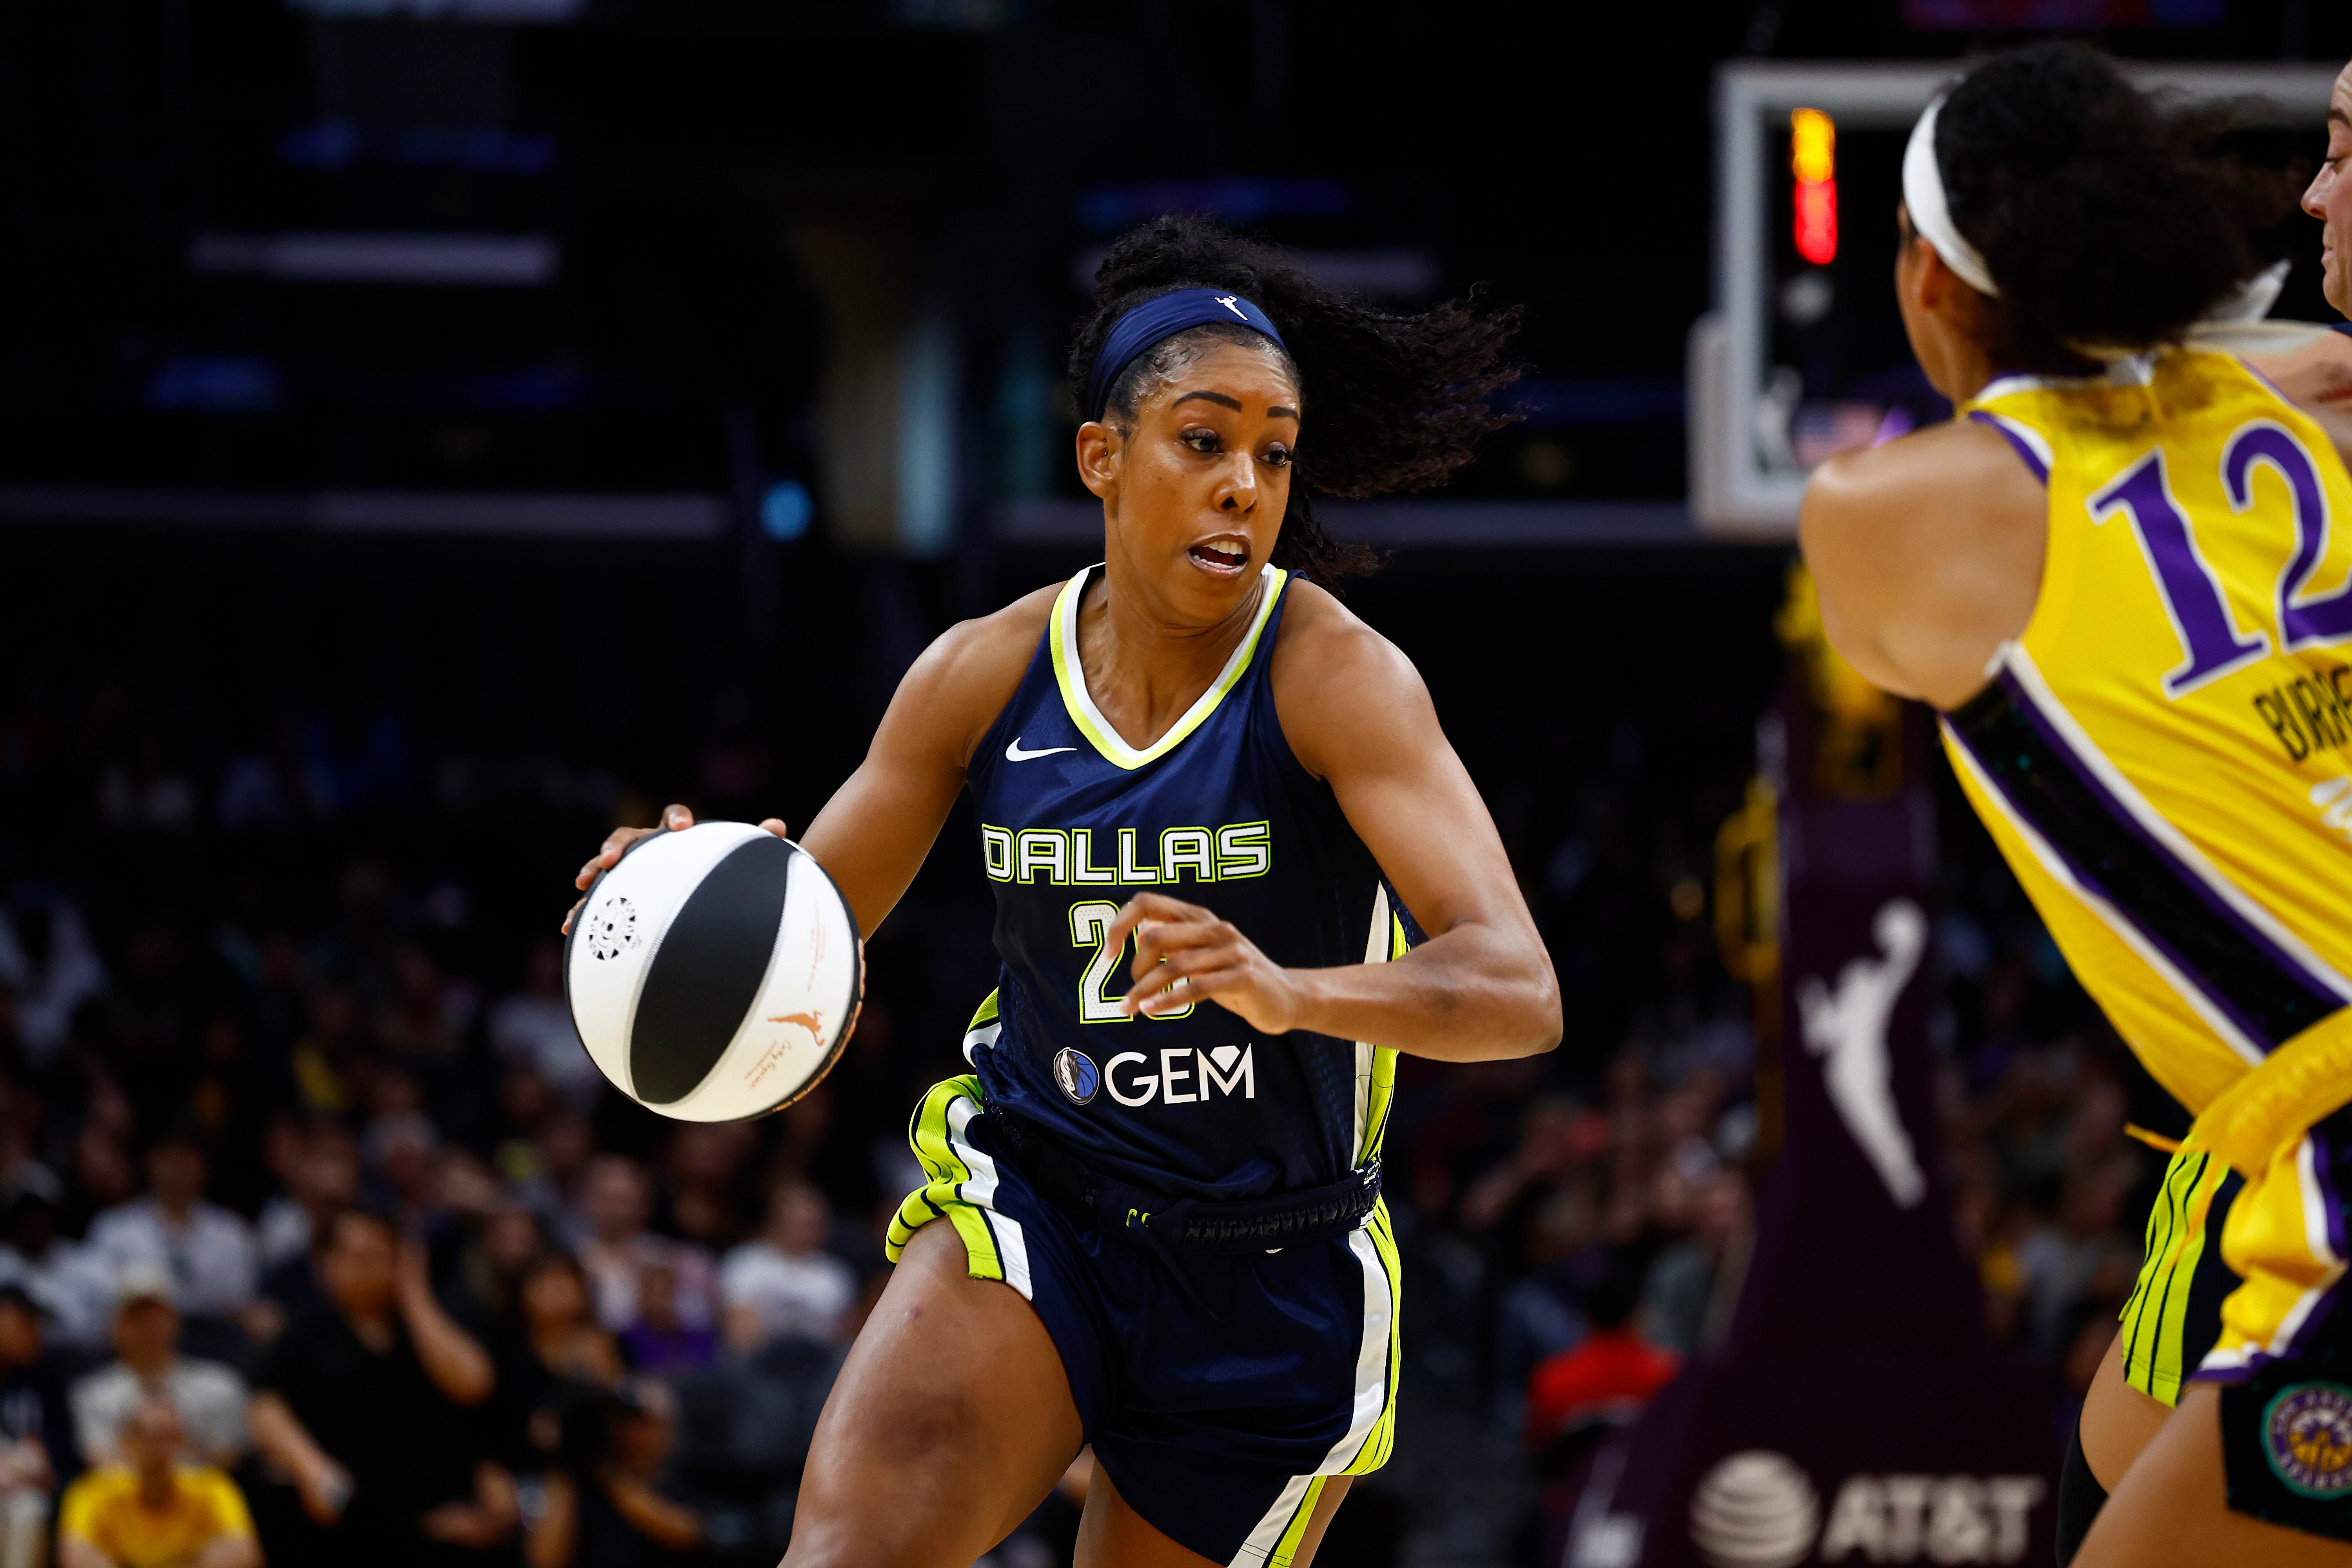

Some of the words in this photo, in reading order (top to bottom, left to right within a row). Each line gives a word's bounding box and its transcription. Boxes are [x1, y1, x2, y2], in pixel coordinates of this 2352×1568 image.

[2083, 417, 2352, 700] 12
[982, 820, 1270, 885] DALLAS
[1069, 900, 1195, 1024] 2
[1104, 1042, 1254, 1107] GEM
[1819, 1472, 2048, 1563] AT&T
